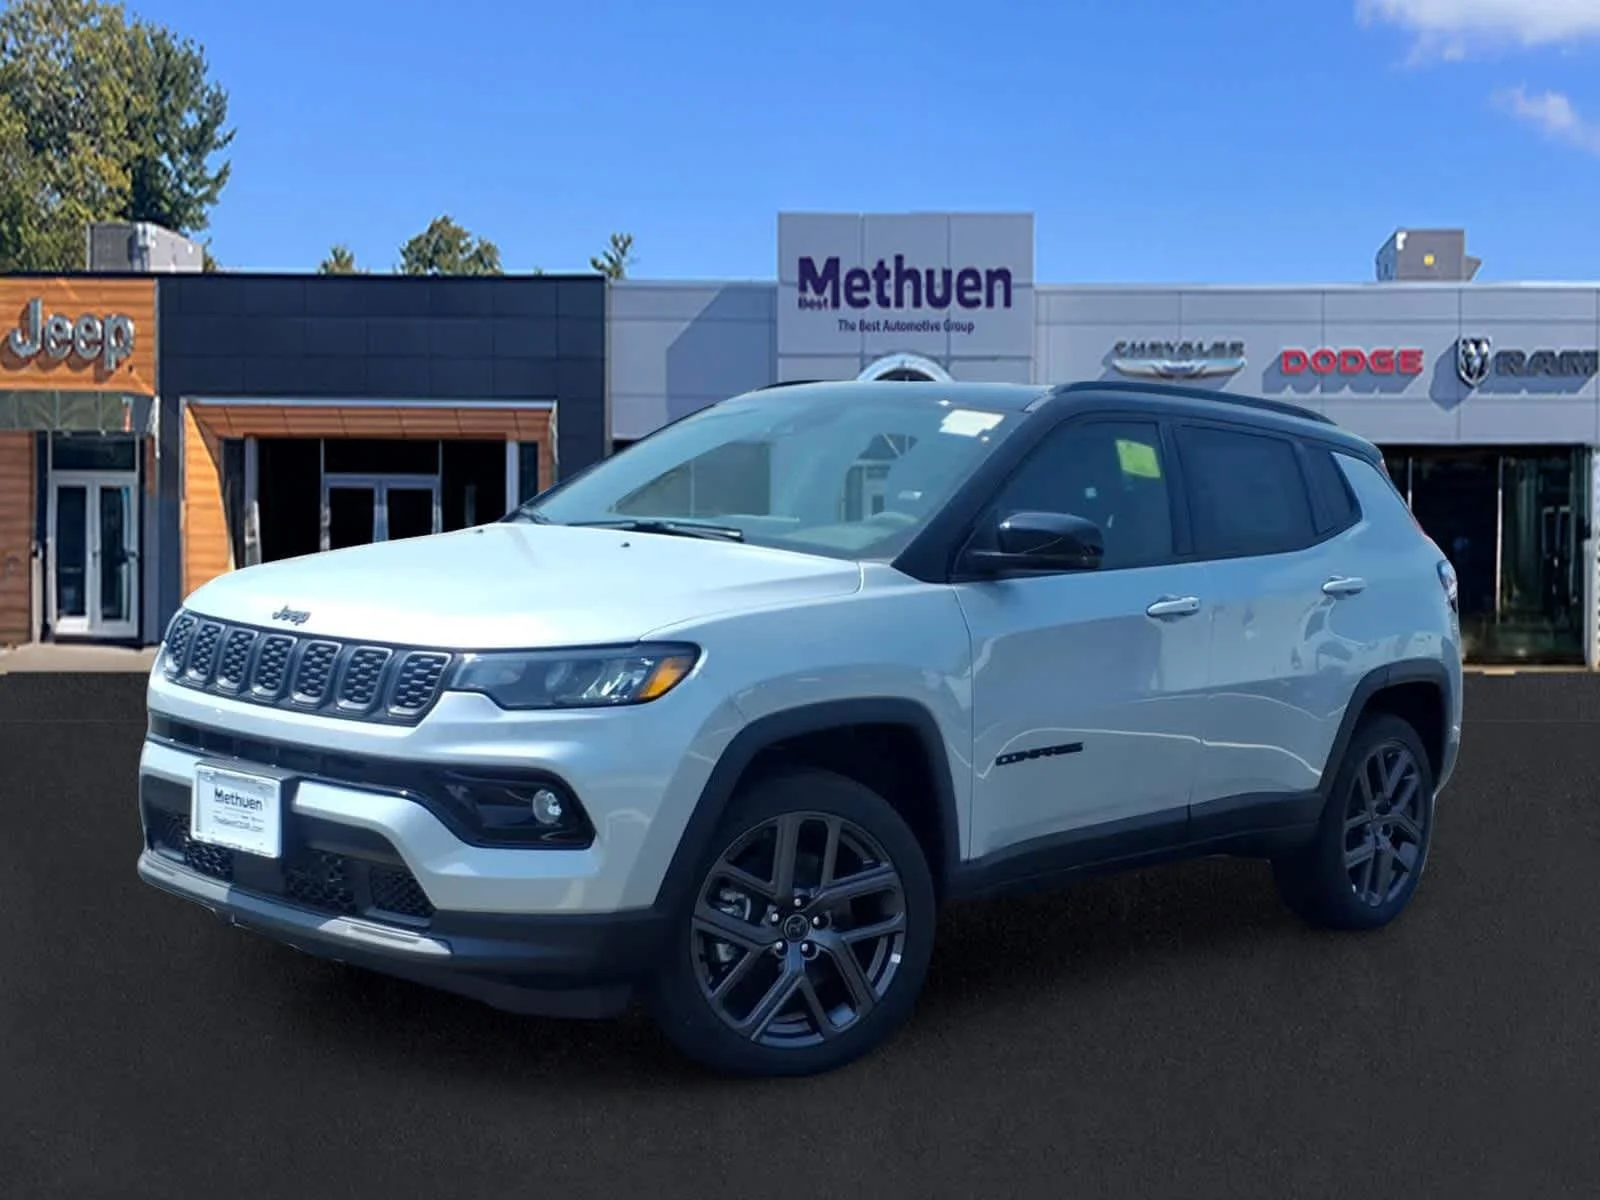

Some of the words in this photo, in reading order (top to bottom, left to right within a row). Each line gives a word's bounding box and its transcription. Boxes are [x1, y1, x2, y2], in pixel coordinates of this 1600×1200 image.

[798, 254, 1012, 309] Methuen
[798, 297, 829, 310] Best
[9, 298, 135, 370] Jeep
[838, 319, 857, 332] The
[859, 319, 881, 332] Best
[883, 319, 940, 333] Automotive
[943, 319, 975, 334] Group
[1113, 340, 1245, 359] CHRYSLER
[1280, 349, 1423, 376] DODGE
[1495, 350, 1598, 377] RAM
[272, 605, 312, 626] Jeep
[214, 787, 263, 812] Methuen
